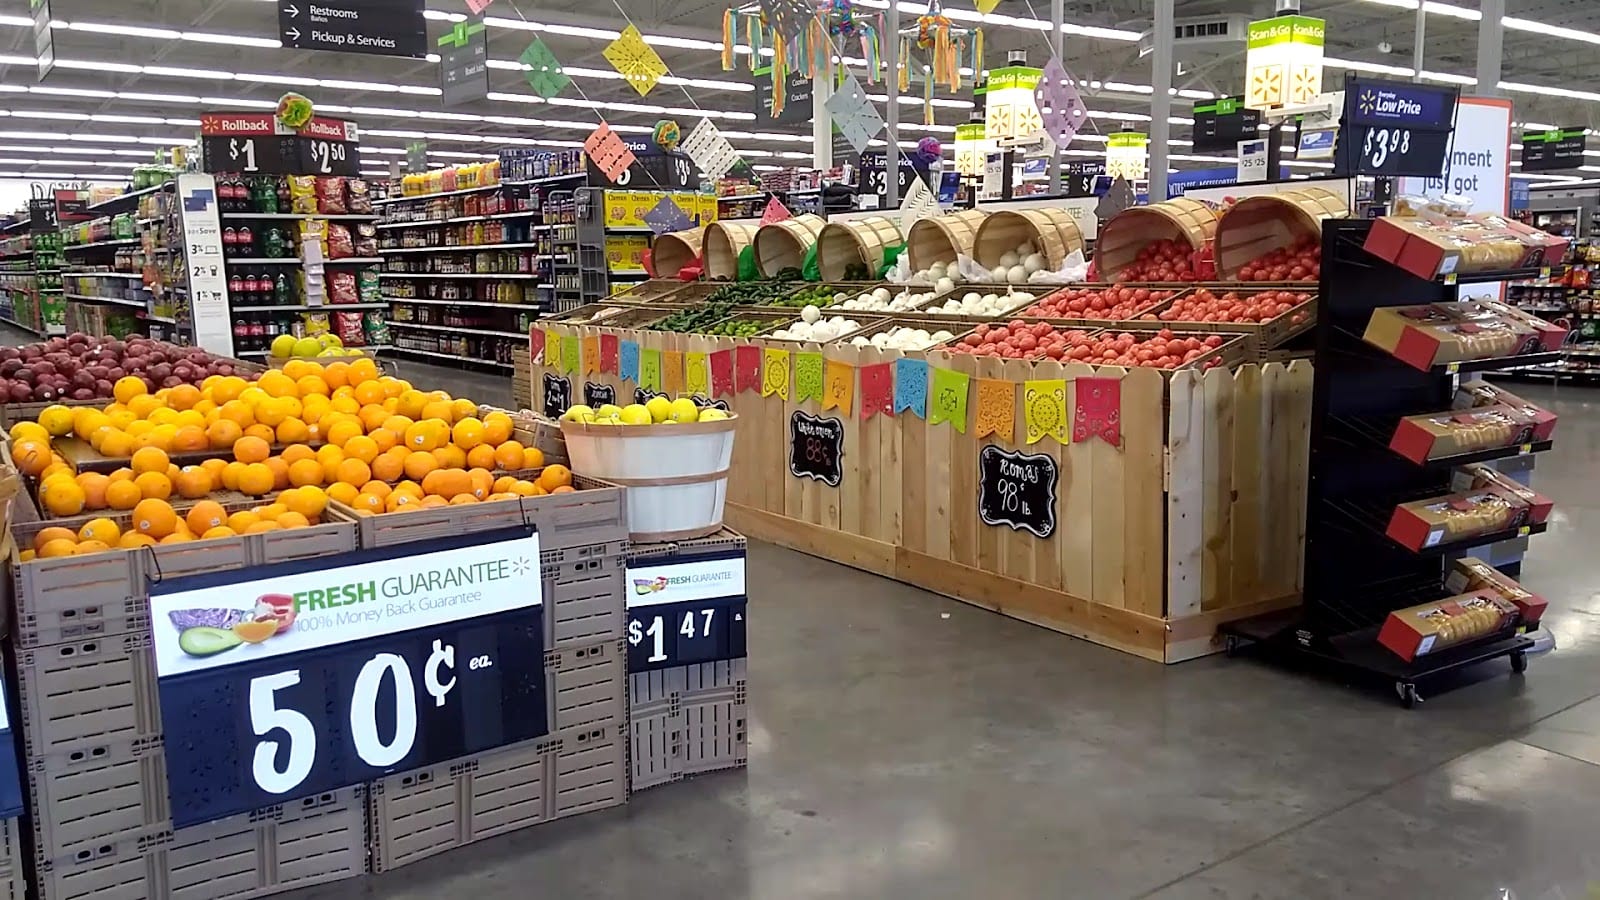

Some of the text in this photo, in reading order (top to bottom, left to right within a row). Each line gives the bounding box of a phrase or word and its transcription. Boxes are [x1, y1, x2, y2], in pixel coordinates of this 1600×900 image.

[310, 5, 358, 19] Restrooms
[311, 30, 396, 48] Pickup & Services
[1376, 98, 1421, 115] Low Price
[222, 120, 269, 131] Rollback
[310, 122, 342, 136] Rollback
[624, 142, 647, 150] Price
[229, 138, 258, 172] $1
[1454, 175, 1478, 195] got
[293, 558, 511, 612] FRESH GUARANTEE
[666, 571, 733, 585] FRESH GUARANTEE
[296, 589, 483, 633] 100% Money Back Guarantee
[468, 653, 493, 671] ea.
